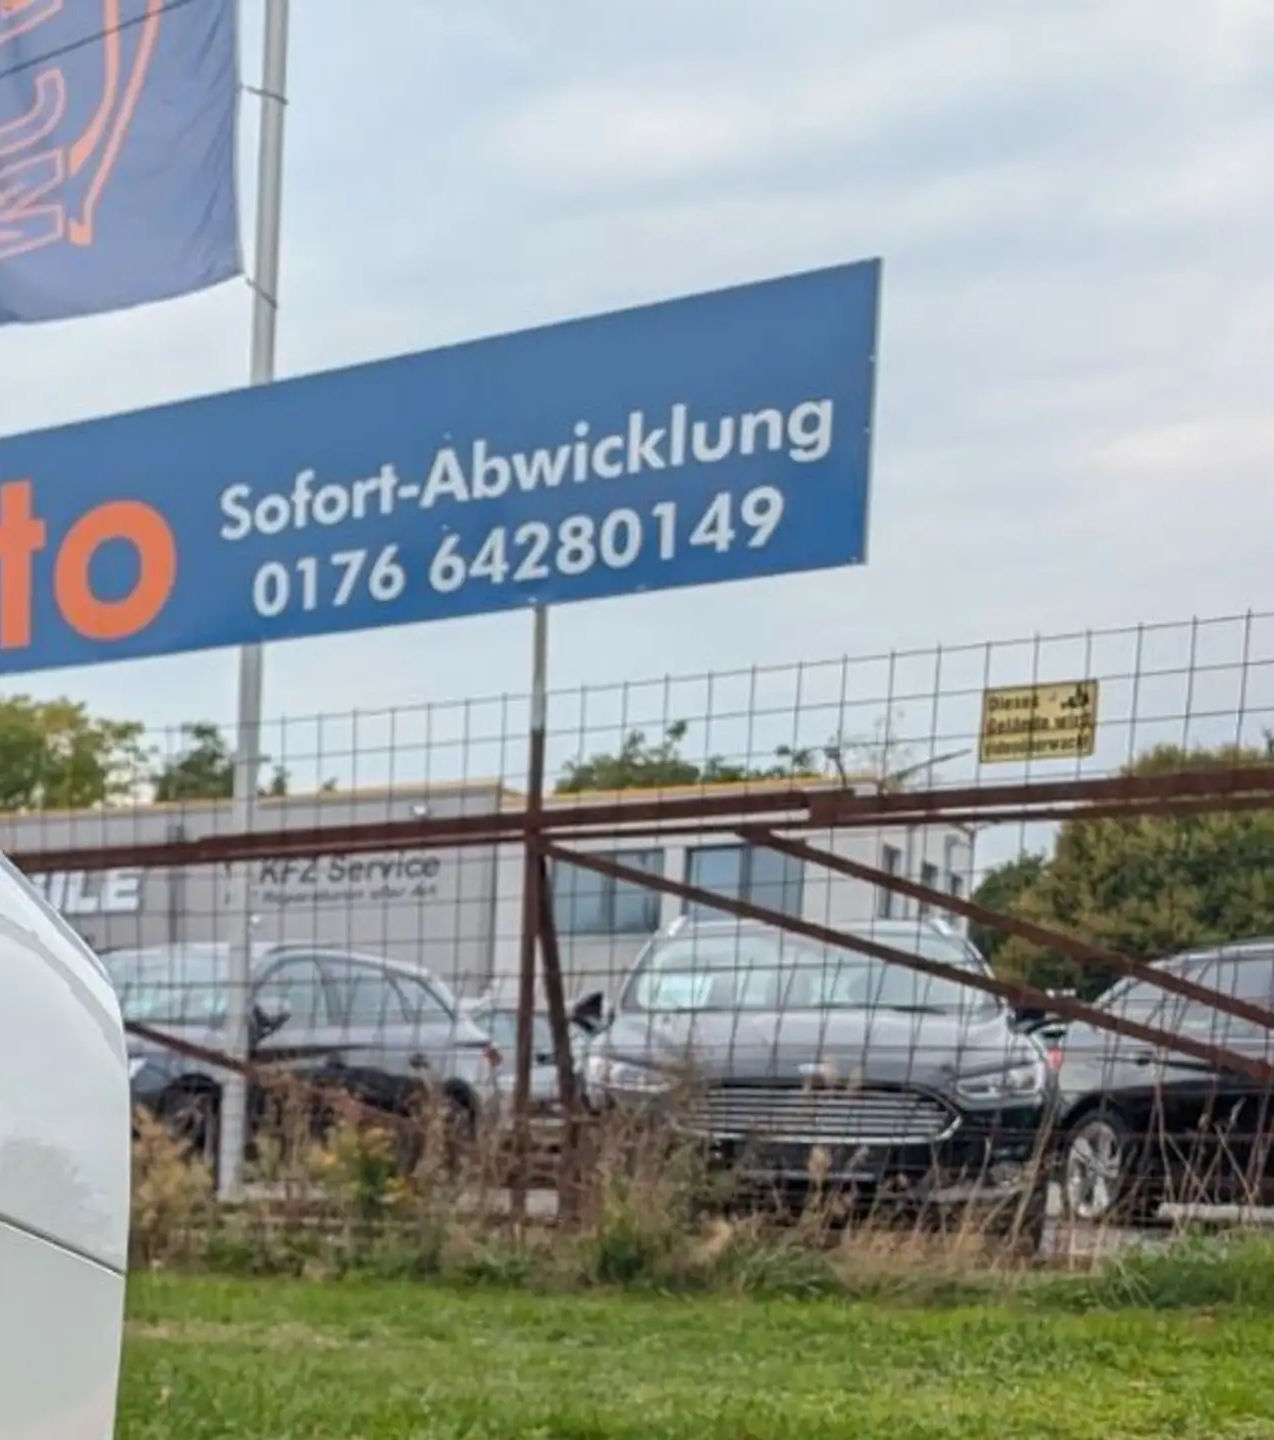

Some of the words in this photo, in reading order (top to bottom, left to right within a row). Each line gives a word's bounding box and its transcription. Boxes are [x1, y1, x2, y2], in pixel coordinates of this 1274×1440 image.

[220, 399, 833, 540] Sofort-Abwicklung
[253, 544, 405, 618] 0176
[428, 485, 785, 594] 64280149
